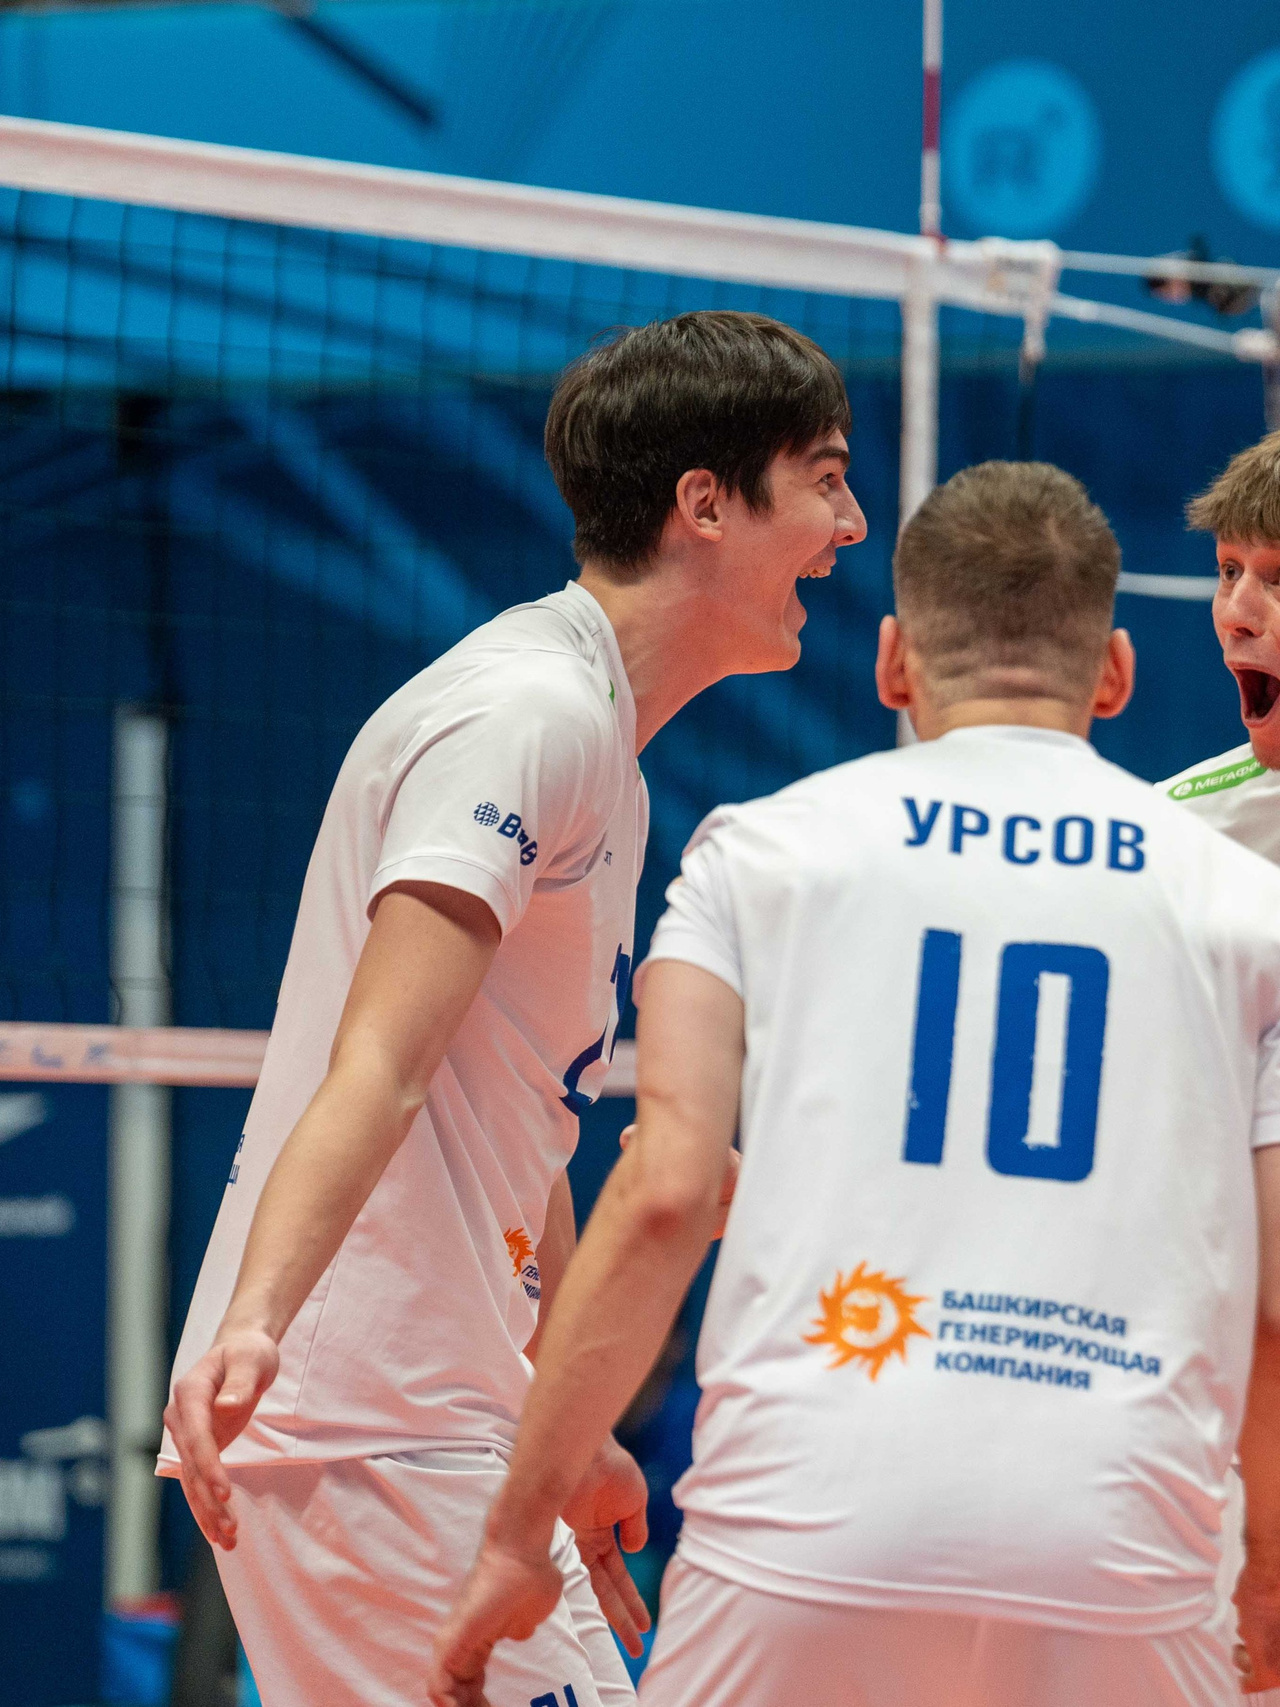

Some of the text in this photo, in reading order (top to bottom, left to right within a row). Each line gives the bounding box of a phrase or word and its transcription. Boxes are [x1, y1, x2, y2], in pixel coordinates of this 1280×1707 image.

[901, 796, 1146, 873] УРСОВ
[902, 927, 1111, 1184] 10
[942, 1289, 1128, 1337] БАШКИРСКАЯ
[935, 1351, 1093, 1391] КОМПАНИЯ
[938, 1320, 1162, 1377] ГЕНЕРИРУЮЩАЯ
